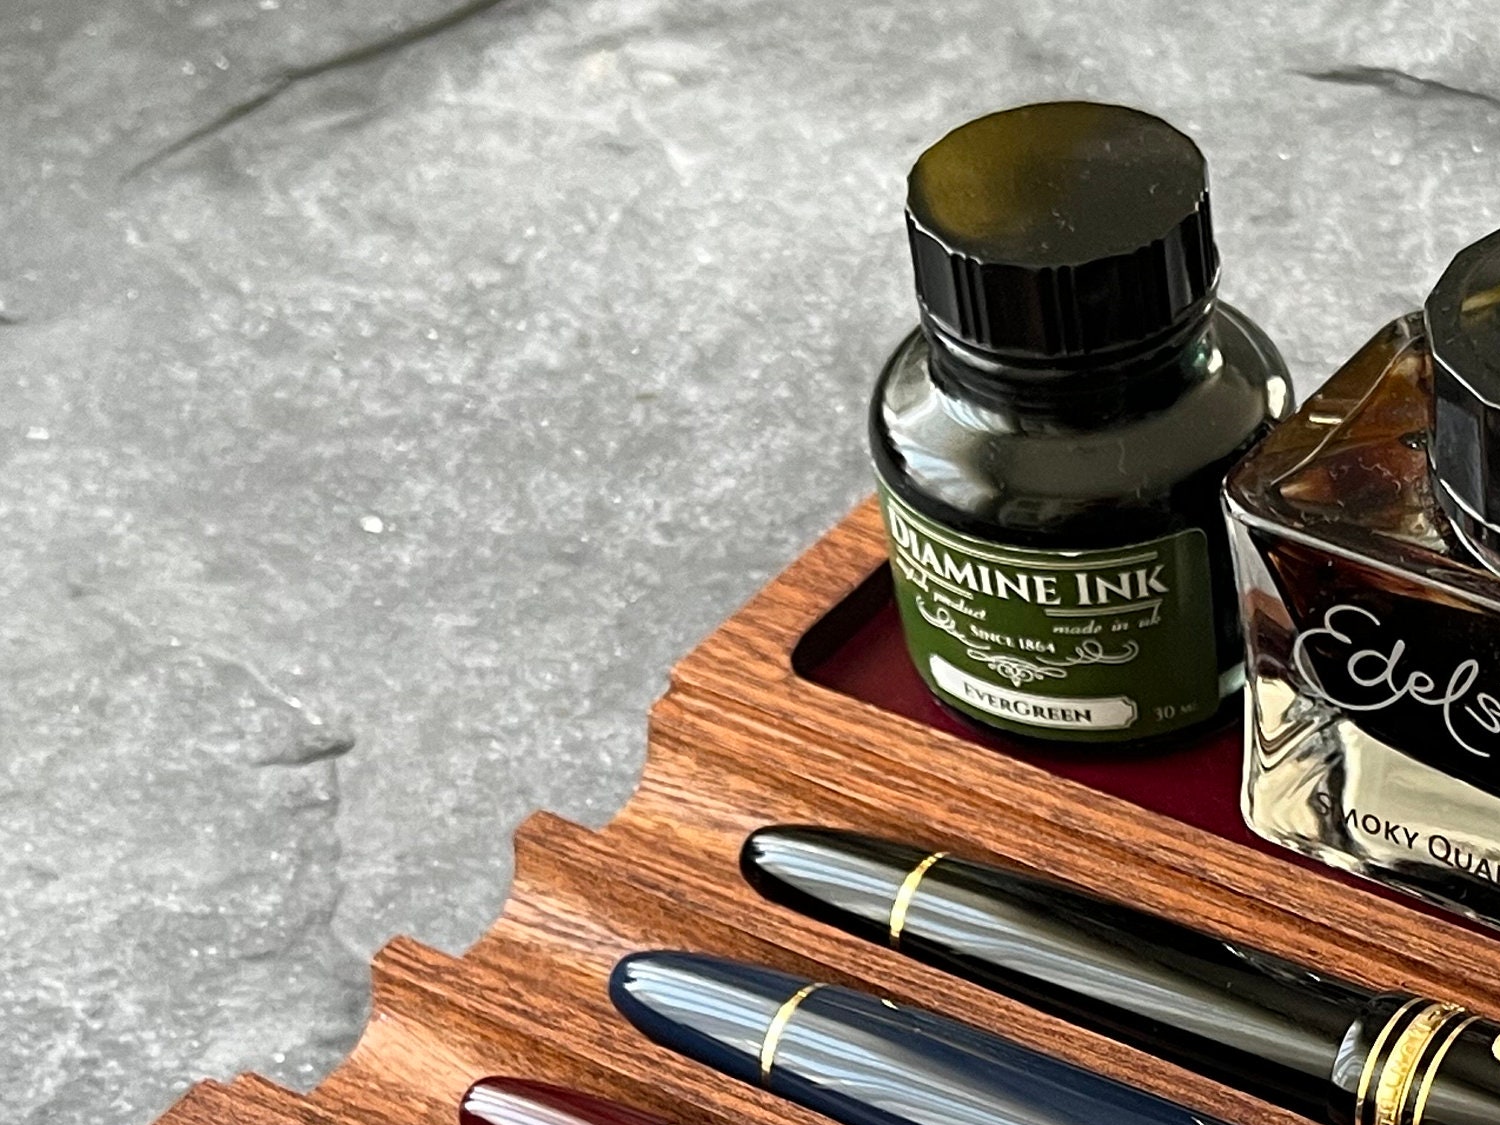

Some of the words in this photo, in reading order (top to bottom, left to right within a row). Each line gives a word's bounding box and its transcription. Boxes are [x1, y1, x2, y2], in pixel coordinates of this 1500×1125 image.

[889, 508, 1061, 606] DIAMINE
[1075, 564, 1169, 607] INK
[1017, 636, 1056, 655] 1864
[963, 680, 1093, 722] EVERGREEN
